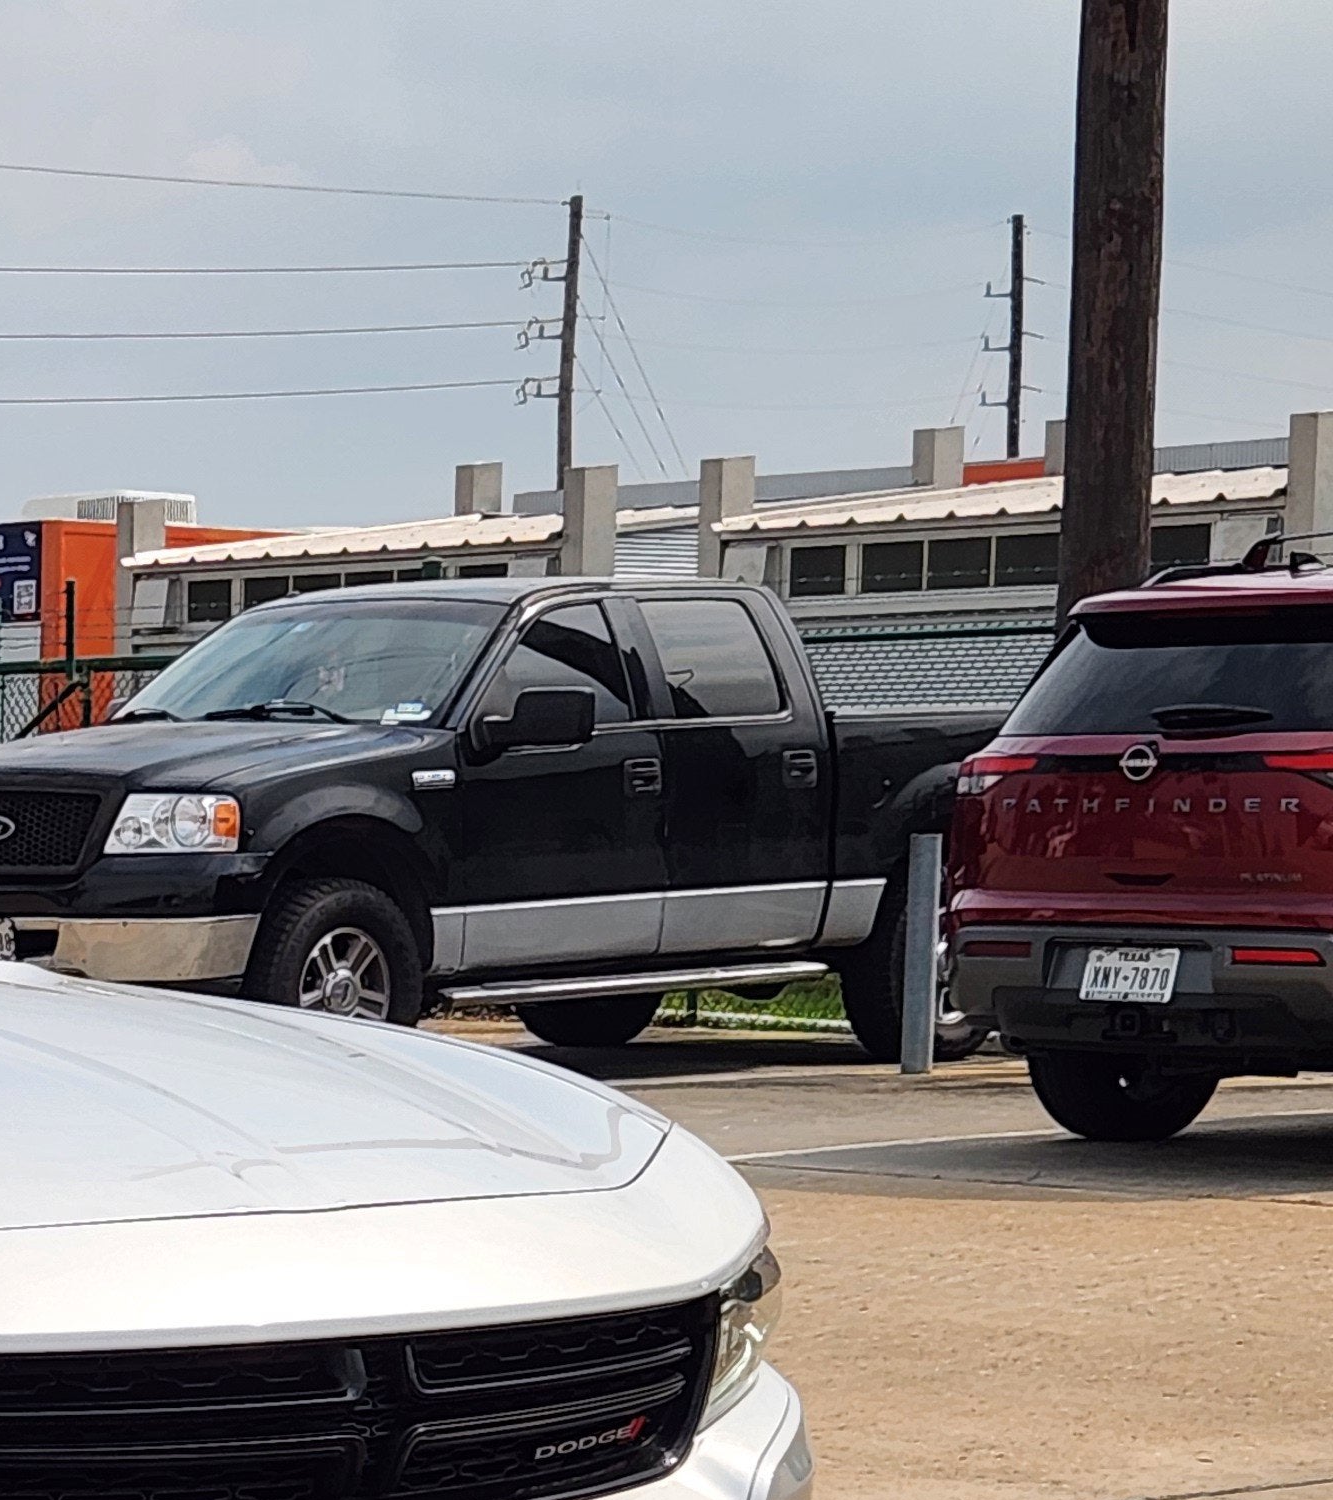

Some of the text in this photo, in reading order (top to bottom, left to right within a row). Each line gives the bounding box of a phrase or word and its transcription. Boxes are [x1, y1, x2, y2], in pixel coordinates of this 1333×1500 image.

[1002, 797, 1301, 813] PATHFINDER
[1118, 951, 1151, 962] TEXAS
[534, 1424, 632, 1460] DODGE
